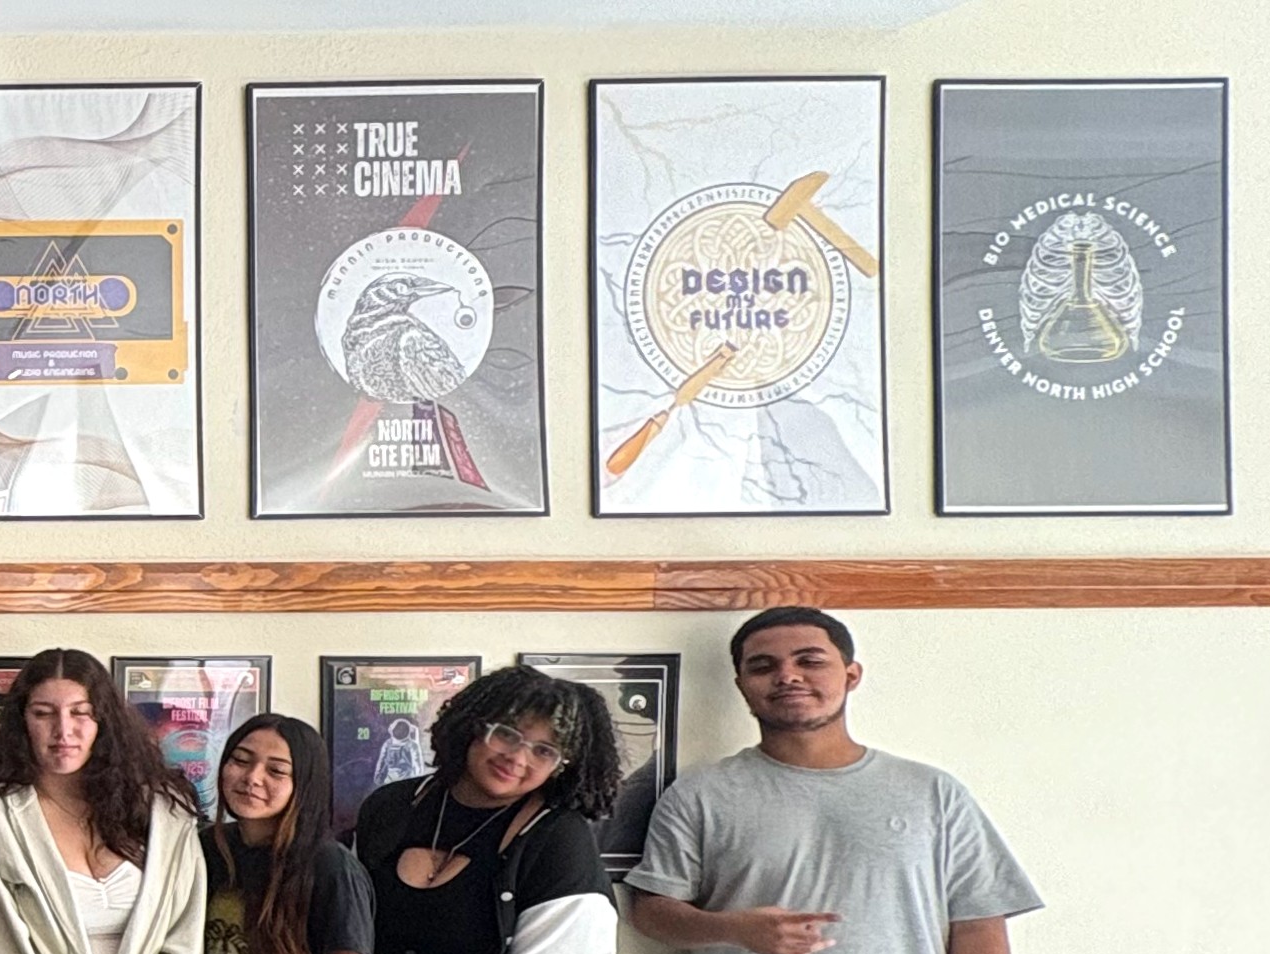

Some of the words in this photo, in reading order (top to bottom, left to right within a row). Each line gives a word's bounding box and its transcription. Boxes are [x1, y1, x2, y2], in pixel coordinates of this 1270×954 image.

[354, 121, 419, 158] TRUE
[354, 160, 462, 197] CINEMA
[983, 231, 1010, 266] BIO
[1010, 193, 1096, 230] MEDICAL
[1102, 196, 1177, 258] SCIENCE
[682, 267, 808, 296] DESIGN
[15, 283, 100, 306] NORTH
[725, 294, 755, 309] MY
[689, 309, 790, 330] FUTURE
[978, 308, 1023, 375] DENVER
[1022, 374, 1086, 400] NORTH
[1092, 374, 1140, 400] HIGH
[1139, 306, 1186, 377] SCHOOL
[377, 419, 433, 442] NORTH
[369, 445, 398, 468] CTE
[401, 444, 441, 467] FILM
[380, 702, 418, 715] FESTIVAL
